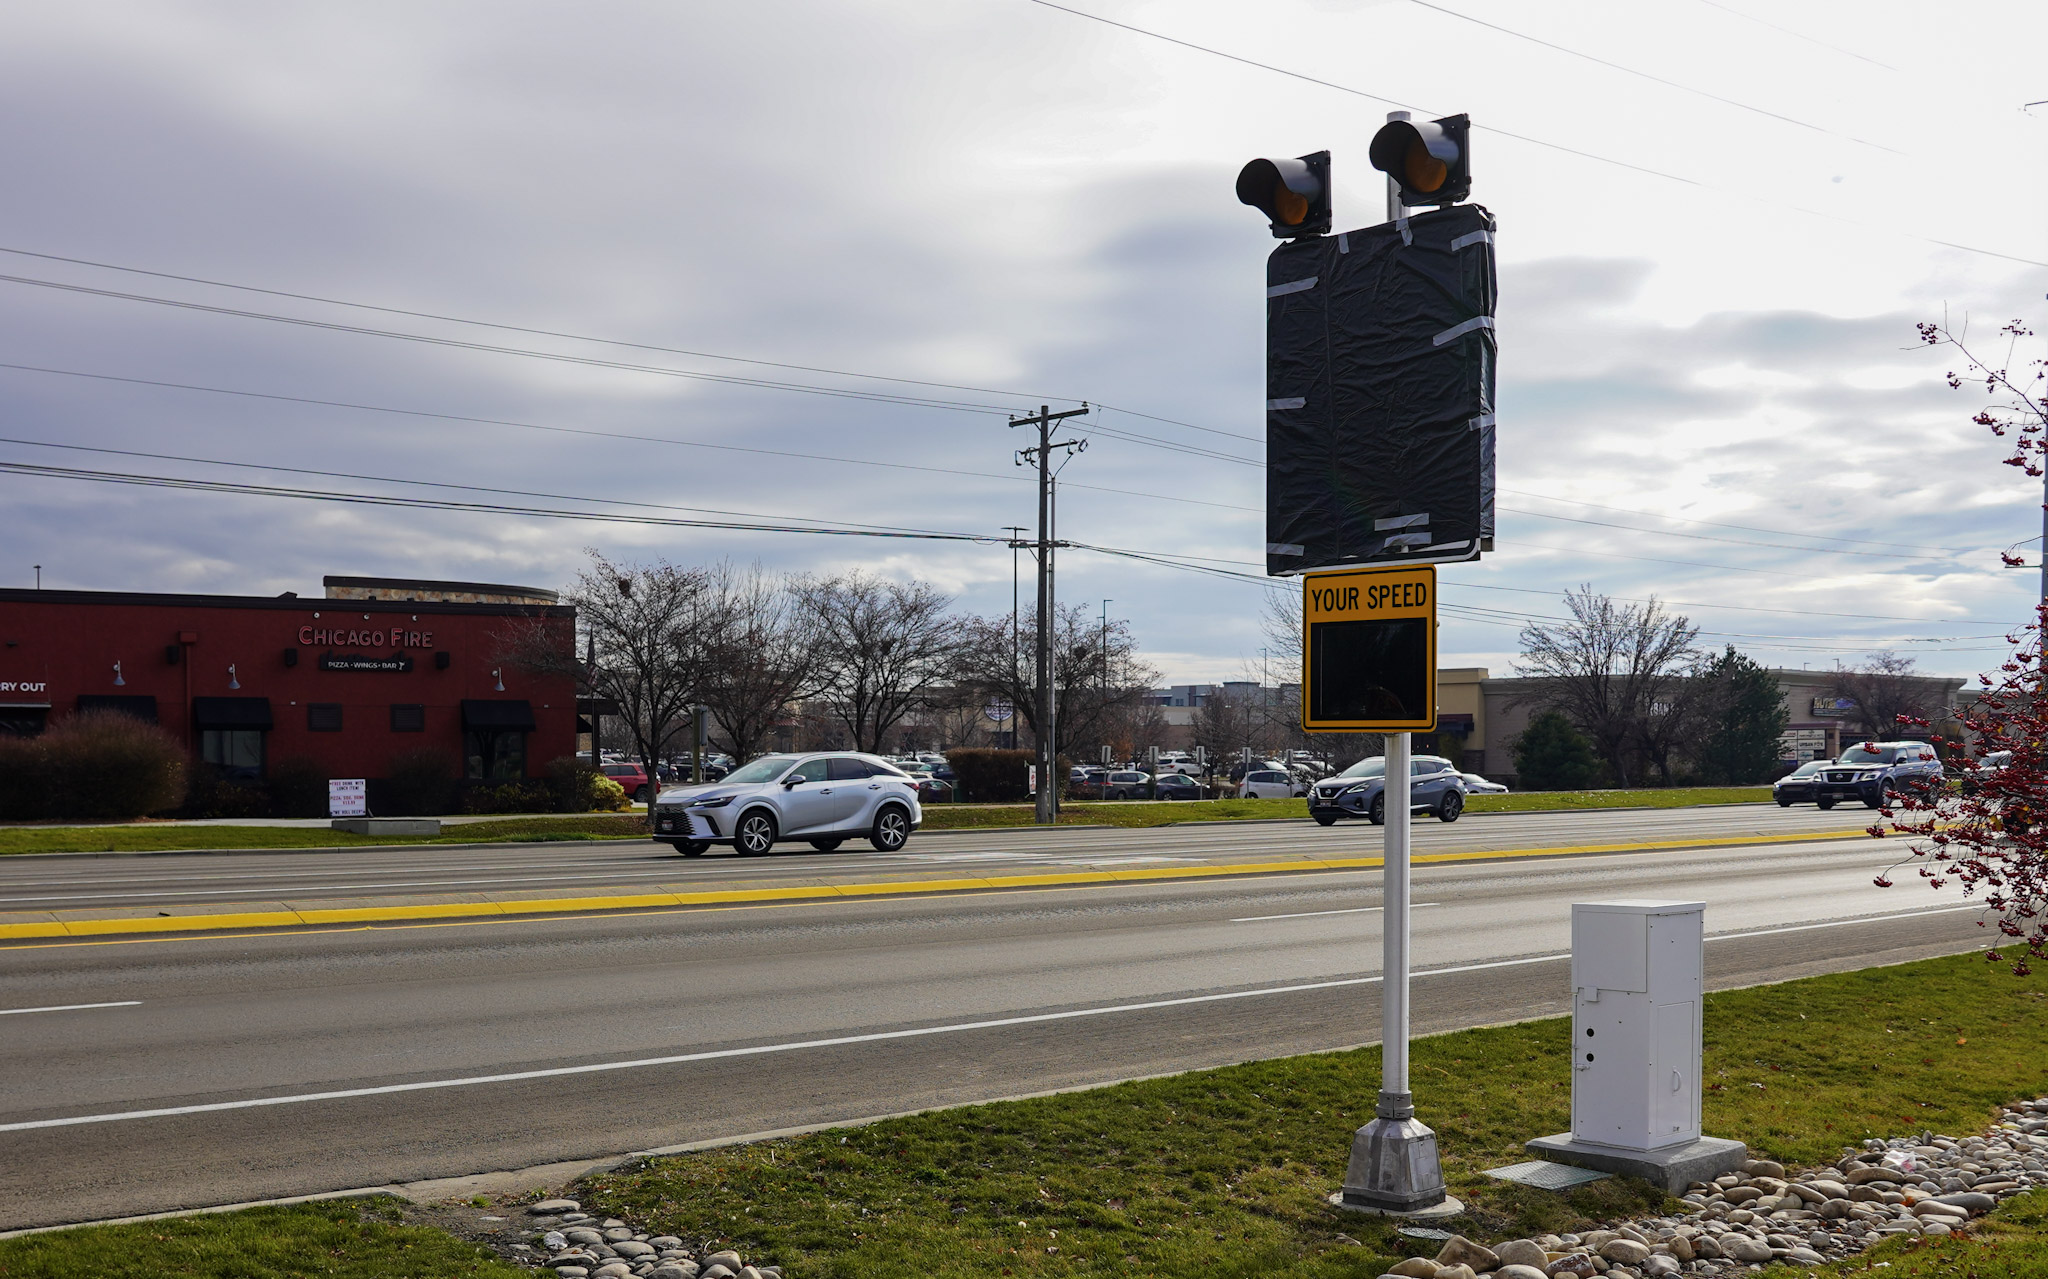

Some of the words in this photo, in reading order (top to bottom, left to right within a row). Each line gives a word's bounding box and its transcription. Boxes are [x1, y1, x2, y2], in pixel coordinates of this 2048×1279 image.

[1311, 587, 1359, 612] YOUR
[1367, 582, 1427, 609] SPEED
[299, 625, 384, 647] CHICAGO
[391, 627, 433, 648] FIRE
[328, 661, 349, 669] PIZZA
[353, 661, 378, 669] WINGS
[0, 682, 17, 691] RY
[20, 682, 46, 692] OUT
